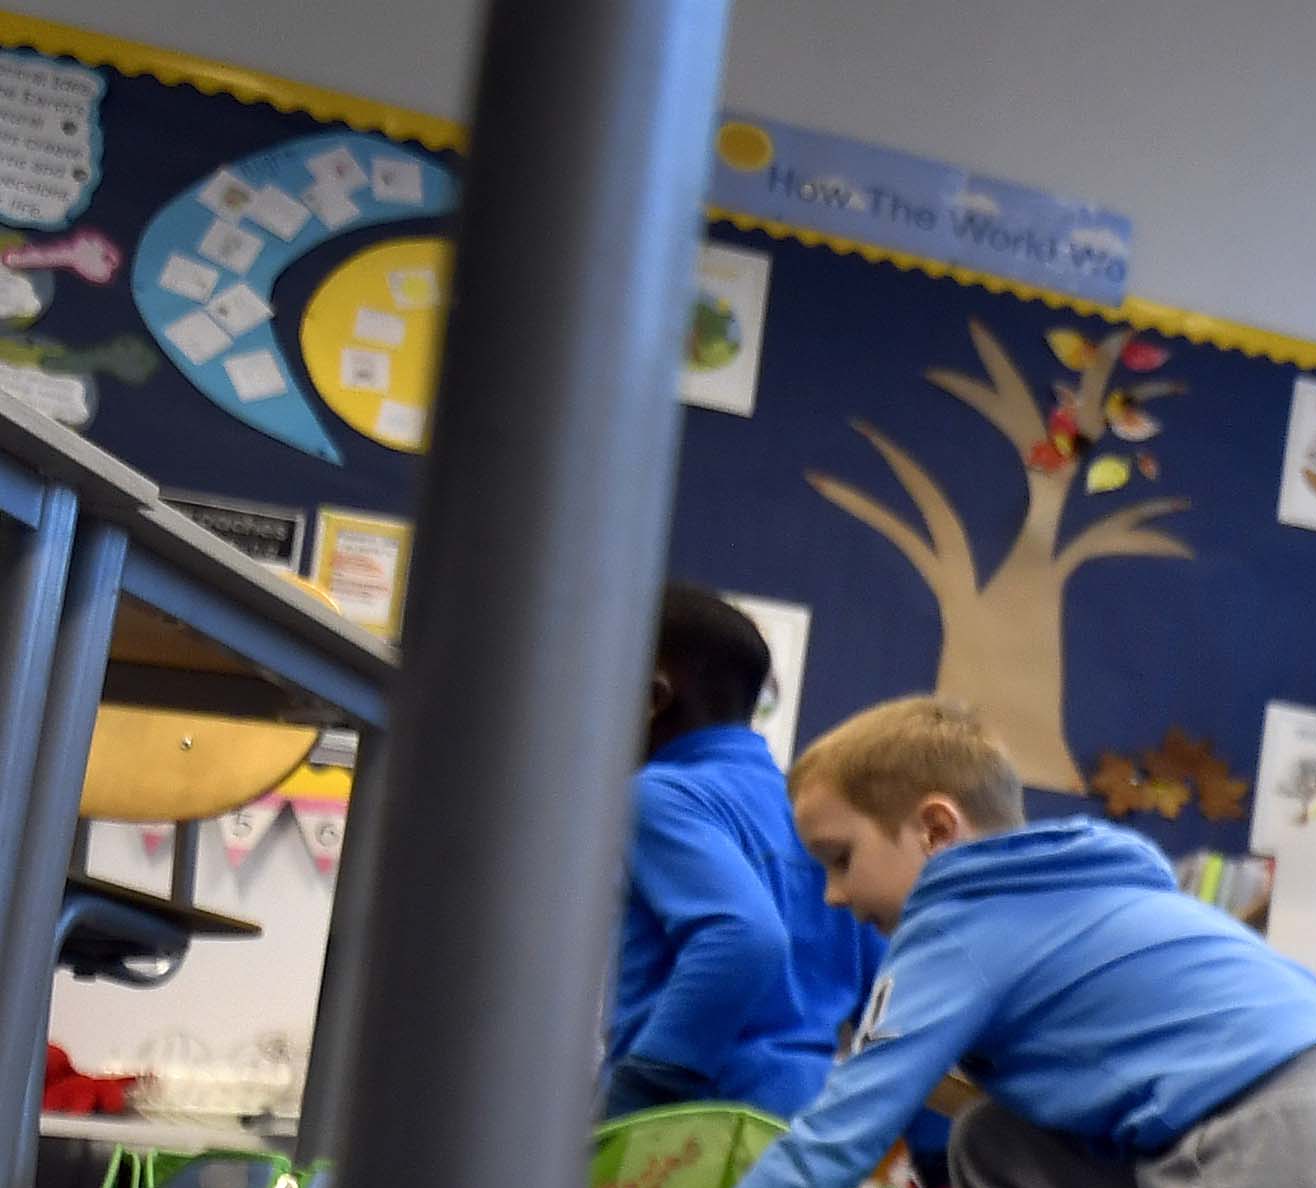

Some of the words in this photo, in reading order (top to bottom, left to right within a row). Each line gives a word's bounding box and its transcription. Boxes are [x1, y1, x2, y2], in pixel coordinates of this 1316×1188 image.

[768, 164, 852, 209] How
[868, 188, 938, 231] The
[949, 208, 1057, 264] World
